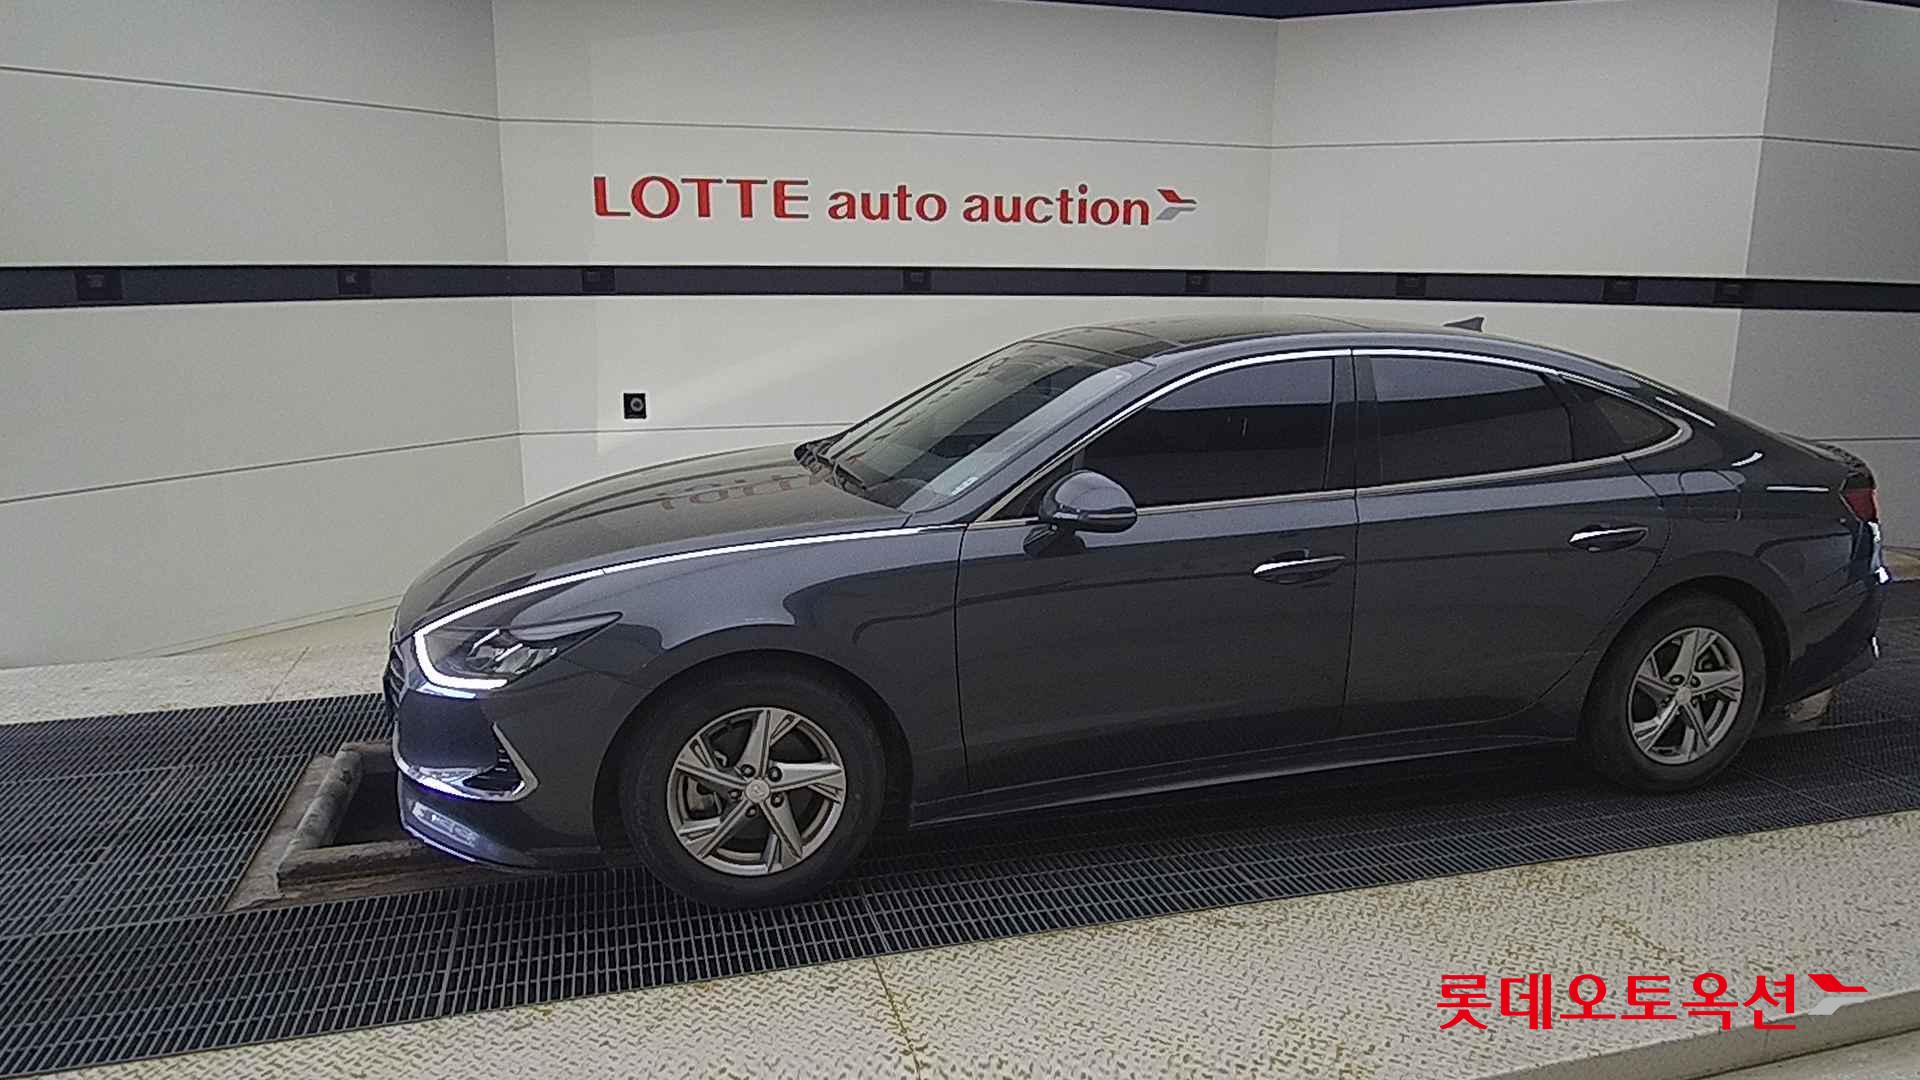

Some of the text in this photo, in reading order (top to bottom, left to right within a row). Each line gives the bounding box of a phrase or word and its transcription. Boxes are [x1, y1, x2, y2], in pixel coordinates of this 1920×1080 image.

[594, 175, 1150, 226] LOTTE auto auction
